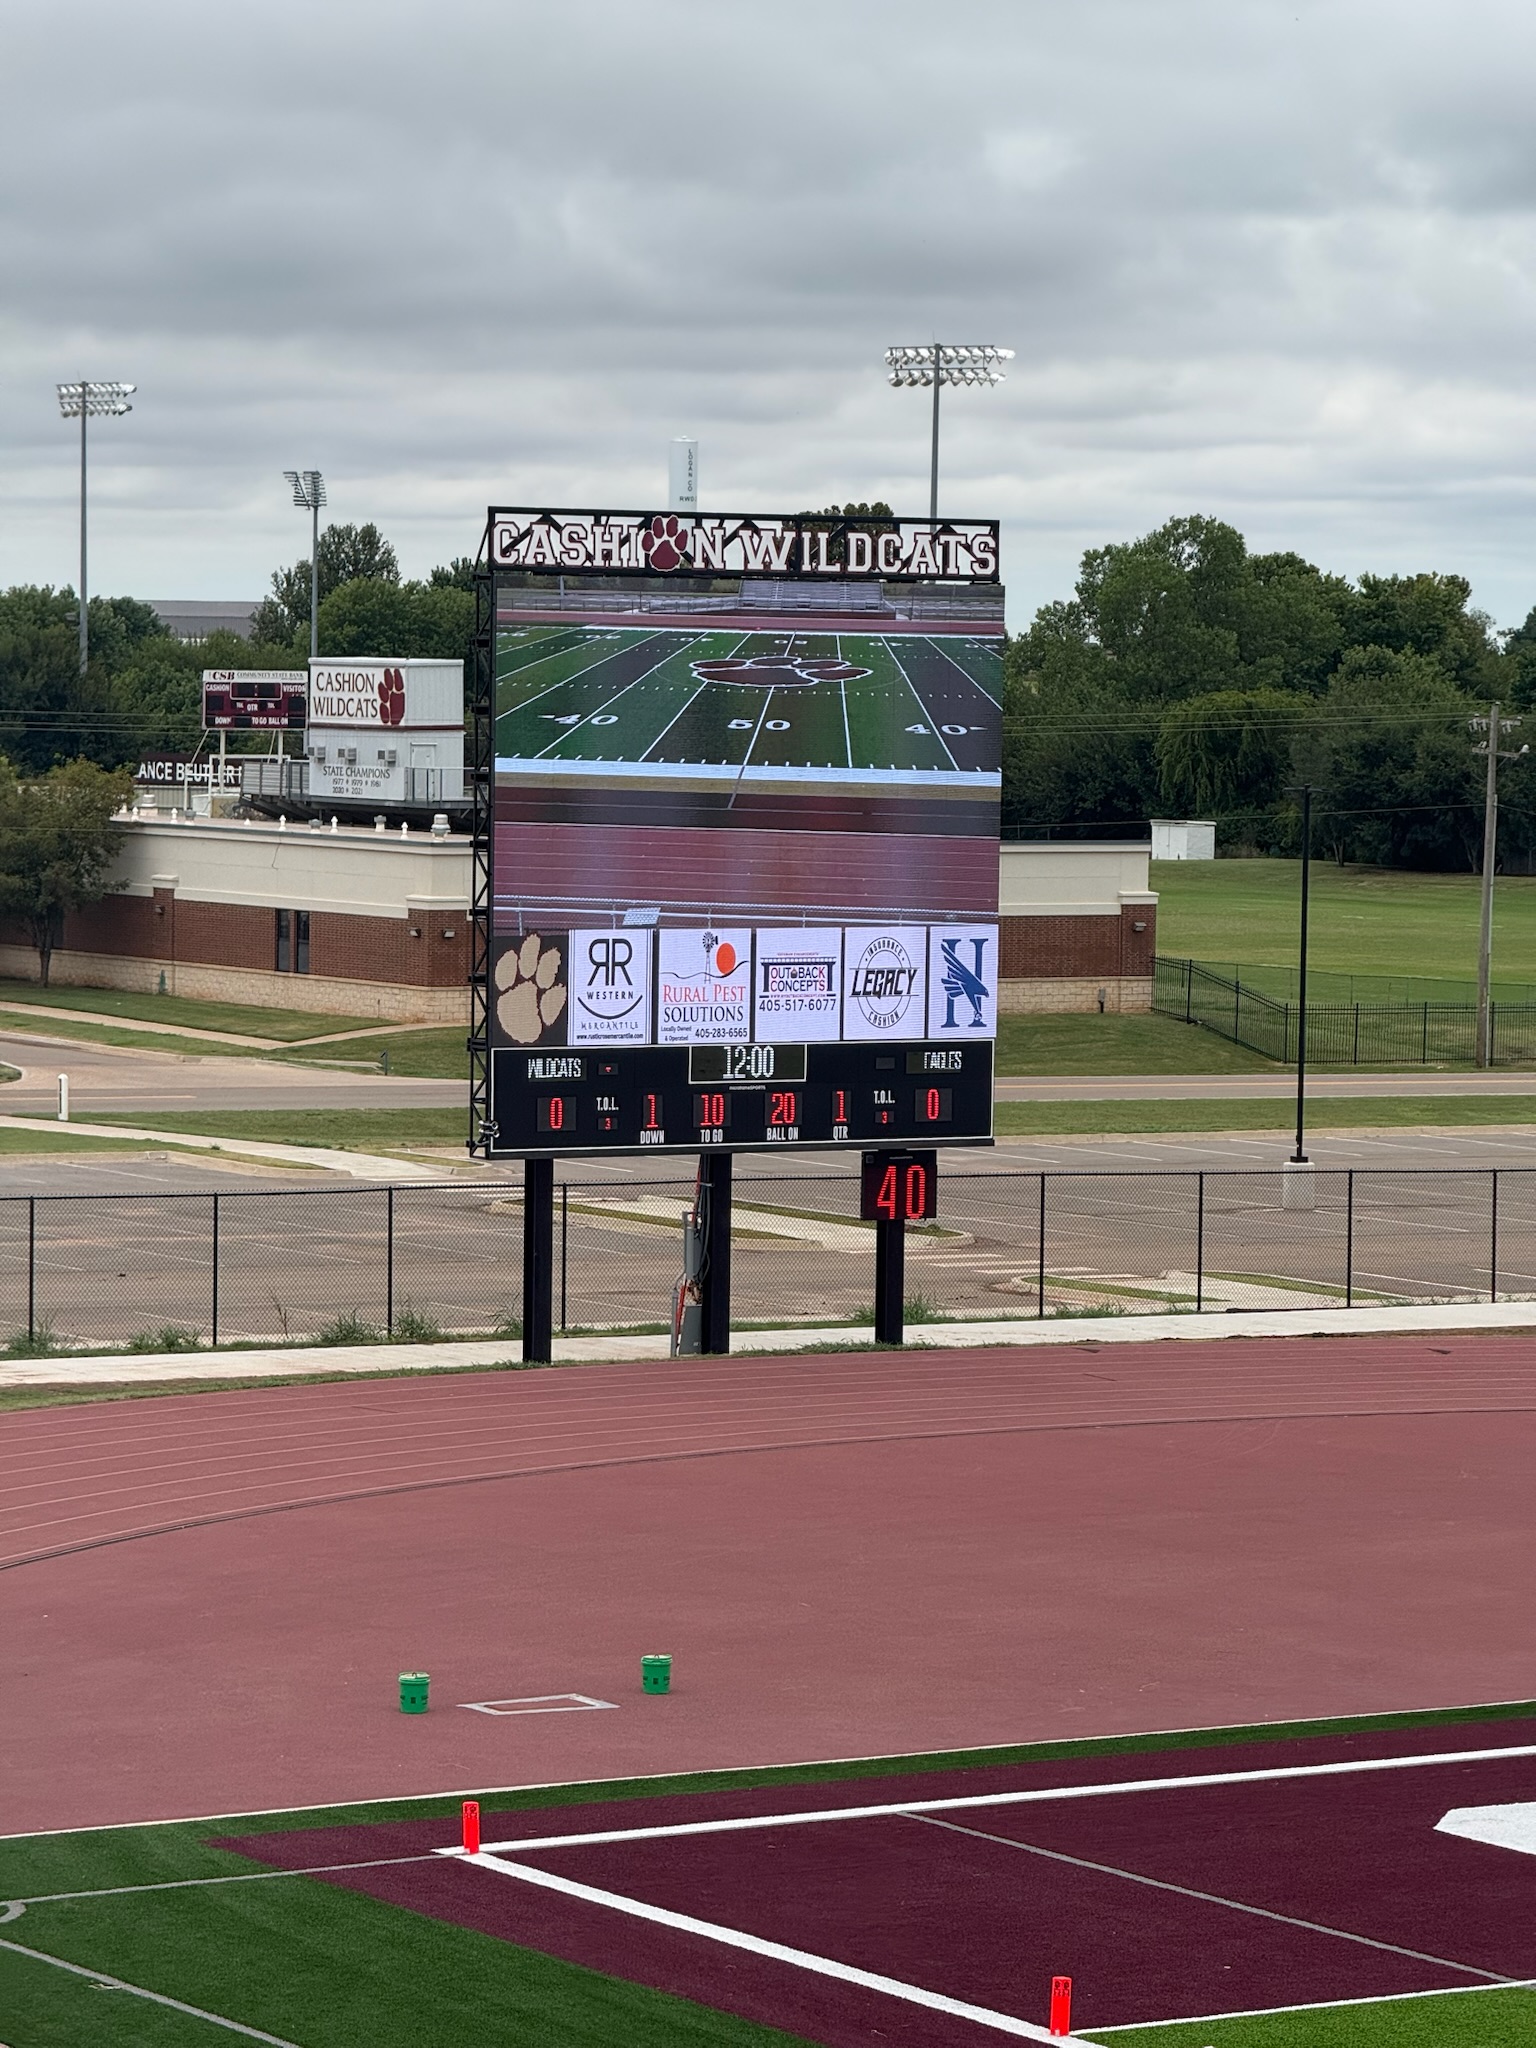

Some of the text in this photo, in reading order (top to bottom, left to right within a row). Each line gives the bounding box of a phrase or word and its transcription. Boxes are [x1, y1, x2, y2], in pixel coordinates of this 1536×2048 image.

[687, 480, 693, 492] CO
[739, 528, 996, 575] WILDCATS
[212, 671, 235, 681] CSB
[316, 672, 375, 694] CASHION
[206, 684, 230, 692] CASHION
[313, 696, 378, 718] WILDCATS
[727, 719, 791, 731] 50
[134, 762, 173, 780] ANCE
[322, 765, 391, 779] STATE CHAMPIONS
[770, 980, 826, 992] CONCEPTS
[851, 969, 919, 999] LEGACY
[587, 991, 634, 1000] WESTERN
[663, 984, 746, 1003] RURAL PEST
[664, 1006, 744, 1023] SOLUTIONS
[868, 1010, 900, 1026] CASHION
[581, 1022, 639, 1031] MERCANTILE
[695, 1027, 748, 1039] 405-283-6565
[527, 1058, 582, 1079] WILDCATS
[722, 1045, 775, 1079] 12:00
[596, 1096, 620, 1111] T.O.L.
[873, 1090, 896, 1105] T.O.L.
[926, 1089, 940, 1121] 0
[550, 1097, 563, 1129] 0
[646, 1095, 659, 1128] 1
[700, 1094, 725, 1126] 10
[771, 1092, 796, 1124] 20
[835, 1090, 848, 1122] 1
[640, 1130, 665, 1144] DOWN
[700, 1128, 724, 1143] TO GO
[766, 1127, 799, 1141] BALL ON
[832, 1125, 849, 1140] QTR
[877, 1165, 926, 1220] 40
